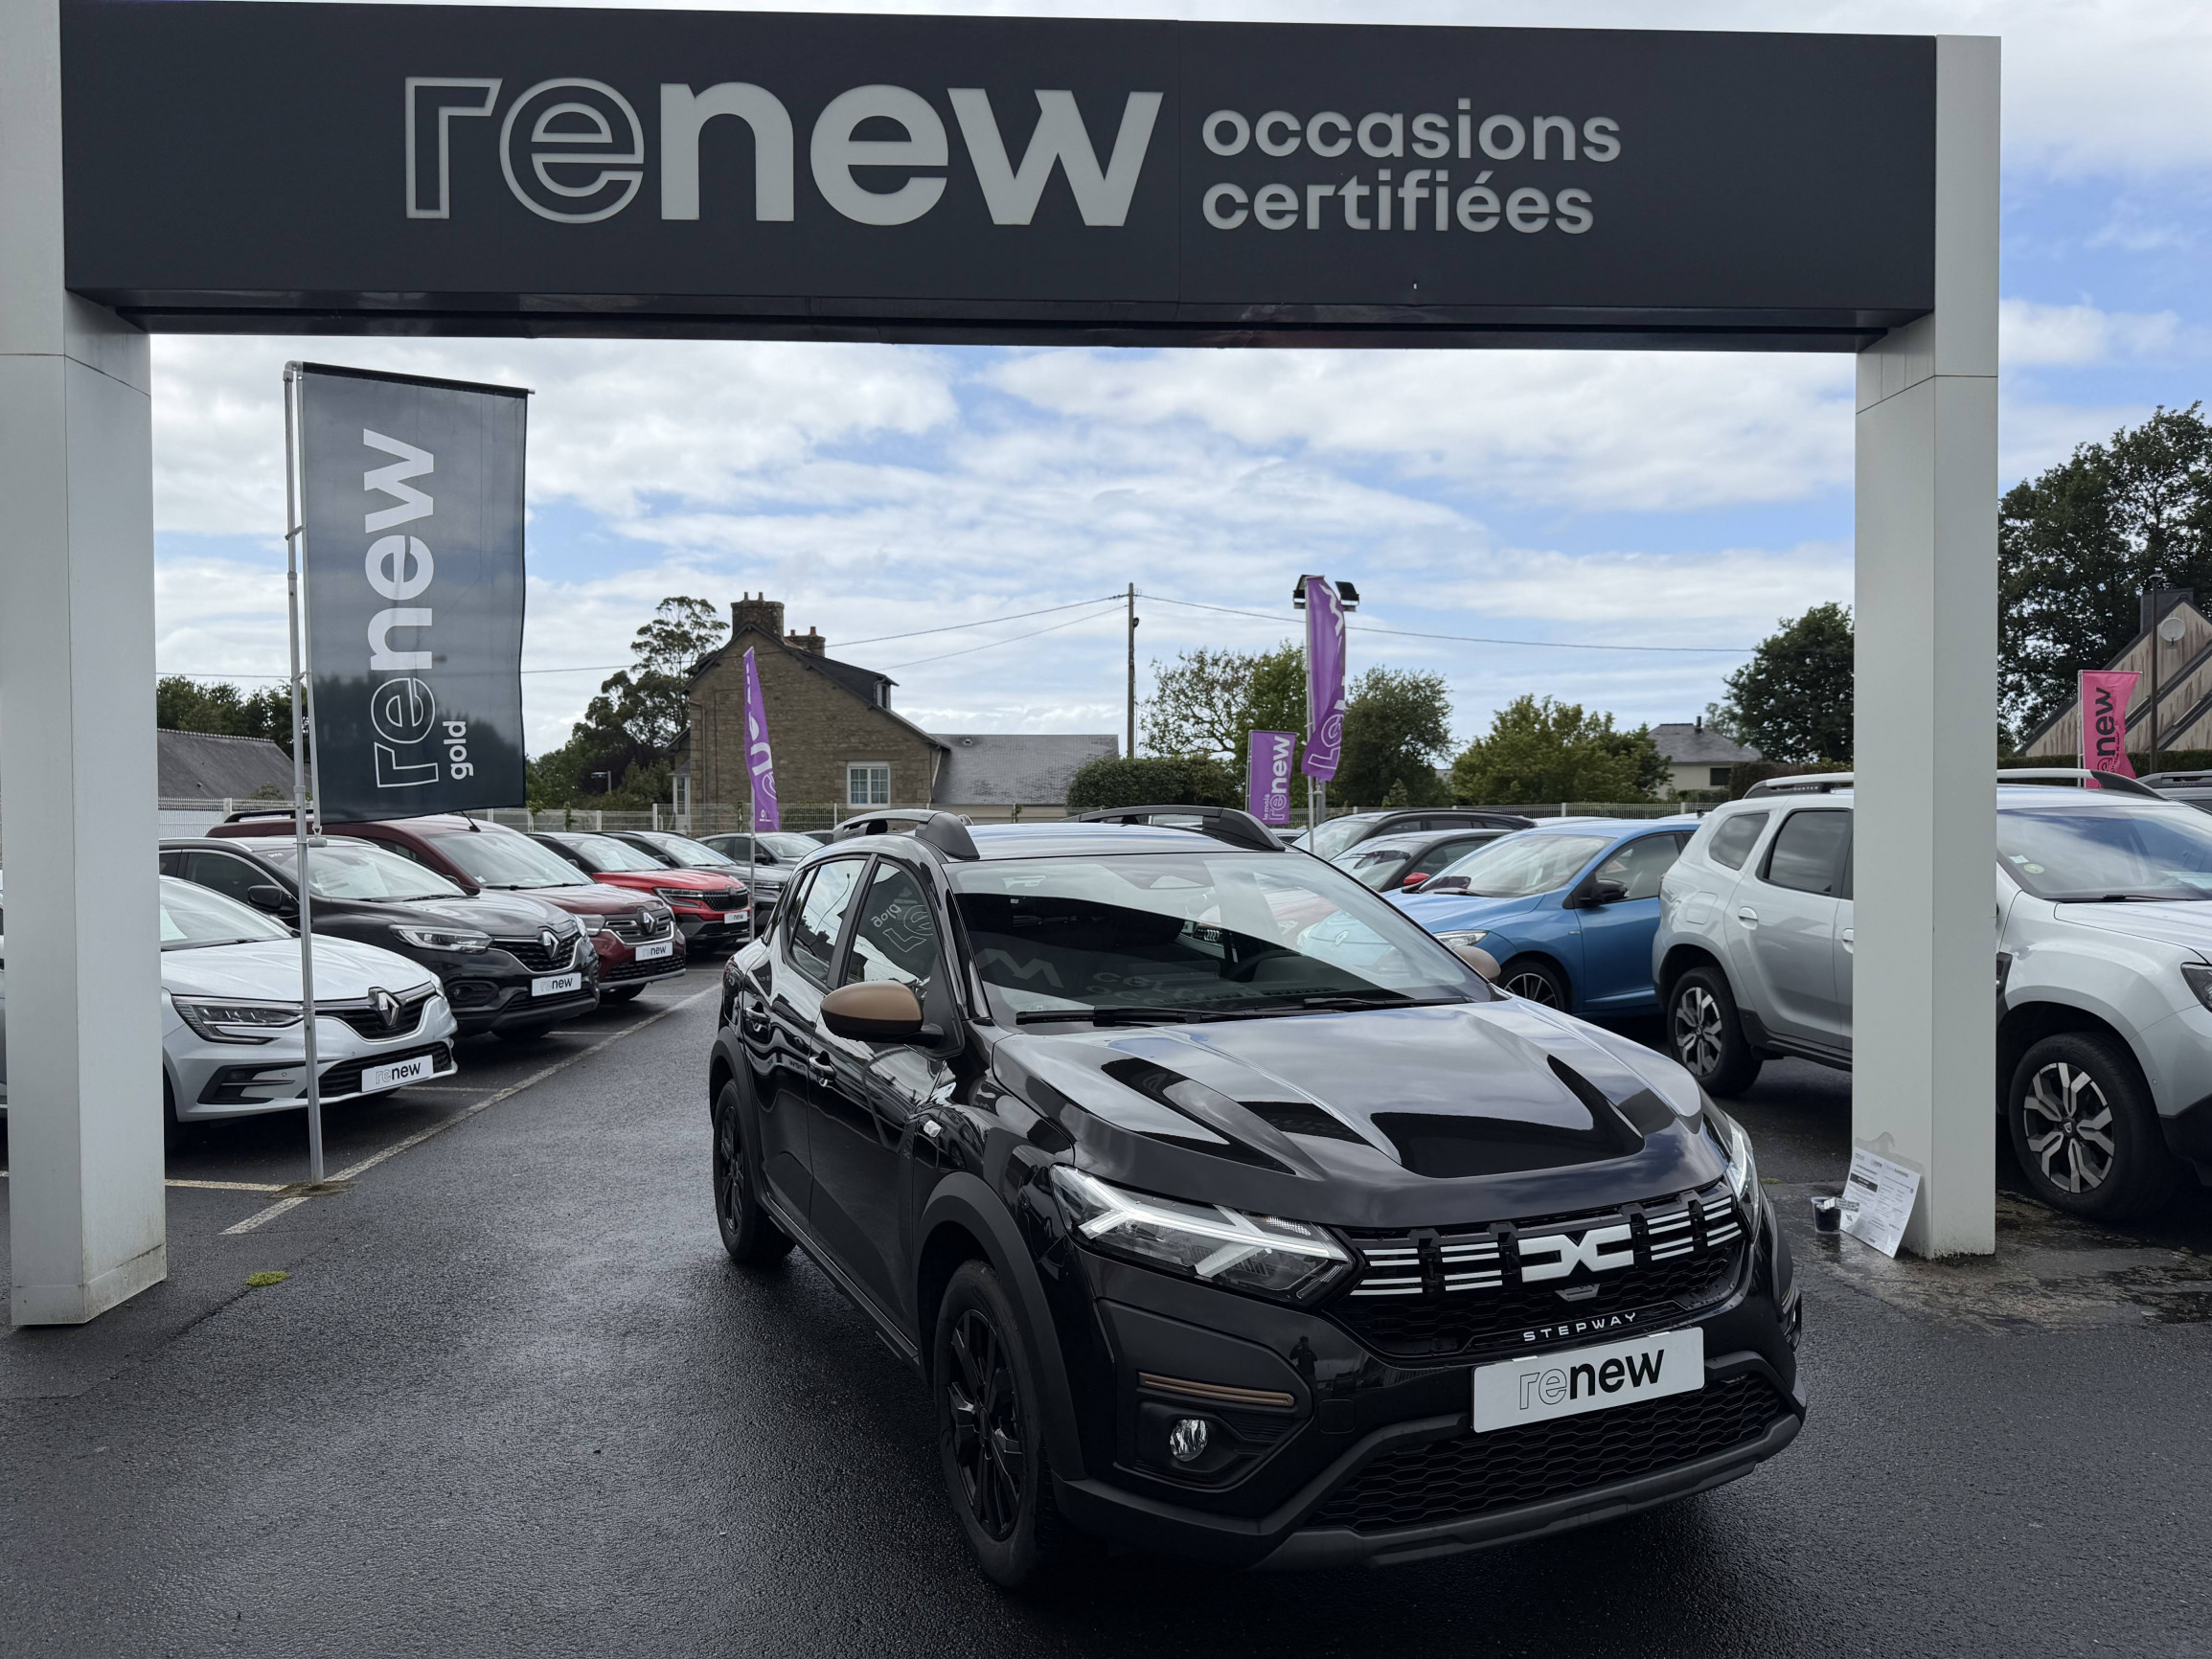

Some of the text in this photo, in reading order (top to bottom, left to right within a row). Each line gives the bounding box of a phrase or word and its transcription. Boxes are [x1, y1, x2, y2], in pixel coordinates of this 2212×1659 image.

[405, 77, 1164, 226] renew
[1201, 98, 1622, 163] occasions
[1201, 169, 1595, 235] certifiées
[363, 428, 439, 788] renew
[443, 720, 473, 781] gold
[1269, 735, 1290, 821] renew
[376, 1061, 422, 1085] renew
[1523, 1312, 1636, 1341] STEPWAY
[1519, 1349, 1665, 1410] renew
